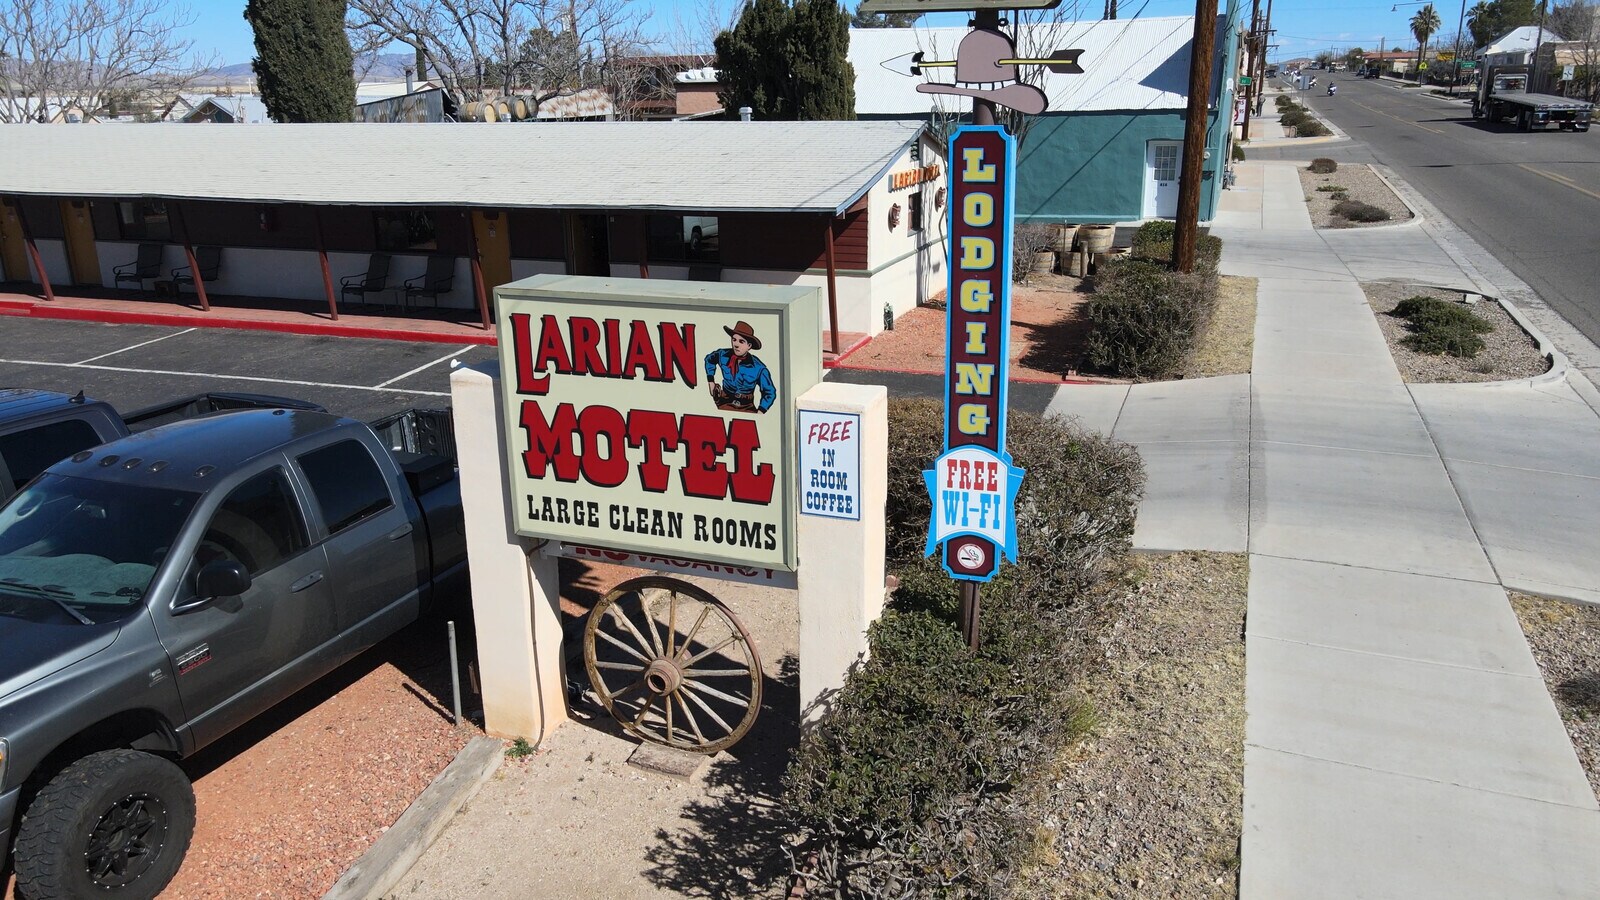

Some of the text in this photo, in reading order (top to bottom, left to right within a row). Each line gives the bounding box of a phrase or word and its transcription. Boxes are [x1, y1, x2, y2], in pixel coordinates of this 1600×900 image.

[955, 147, 996, 435] LODGING
[509, 313, 697, 396] LARIAN
[808, 420, 853, 445] FREE
[519, 400, 775, 506] MOTEL
[822, 448, 835, 468] IN
[810, 469, 848, 491] ROOM
[946, 459, 998, 492] FREE
[806, 491, 852, 514] COFFEE
[942, 490, 1001, 530] WI-FI
[527, 494, 777, 551] LARGE CLEAN ROOMS
